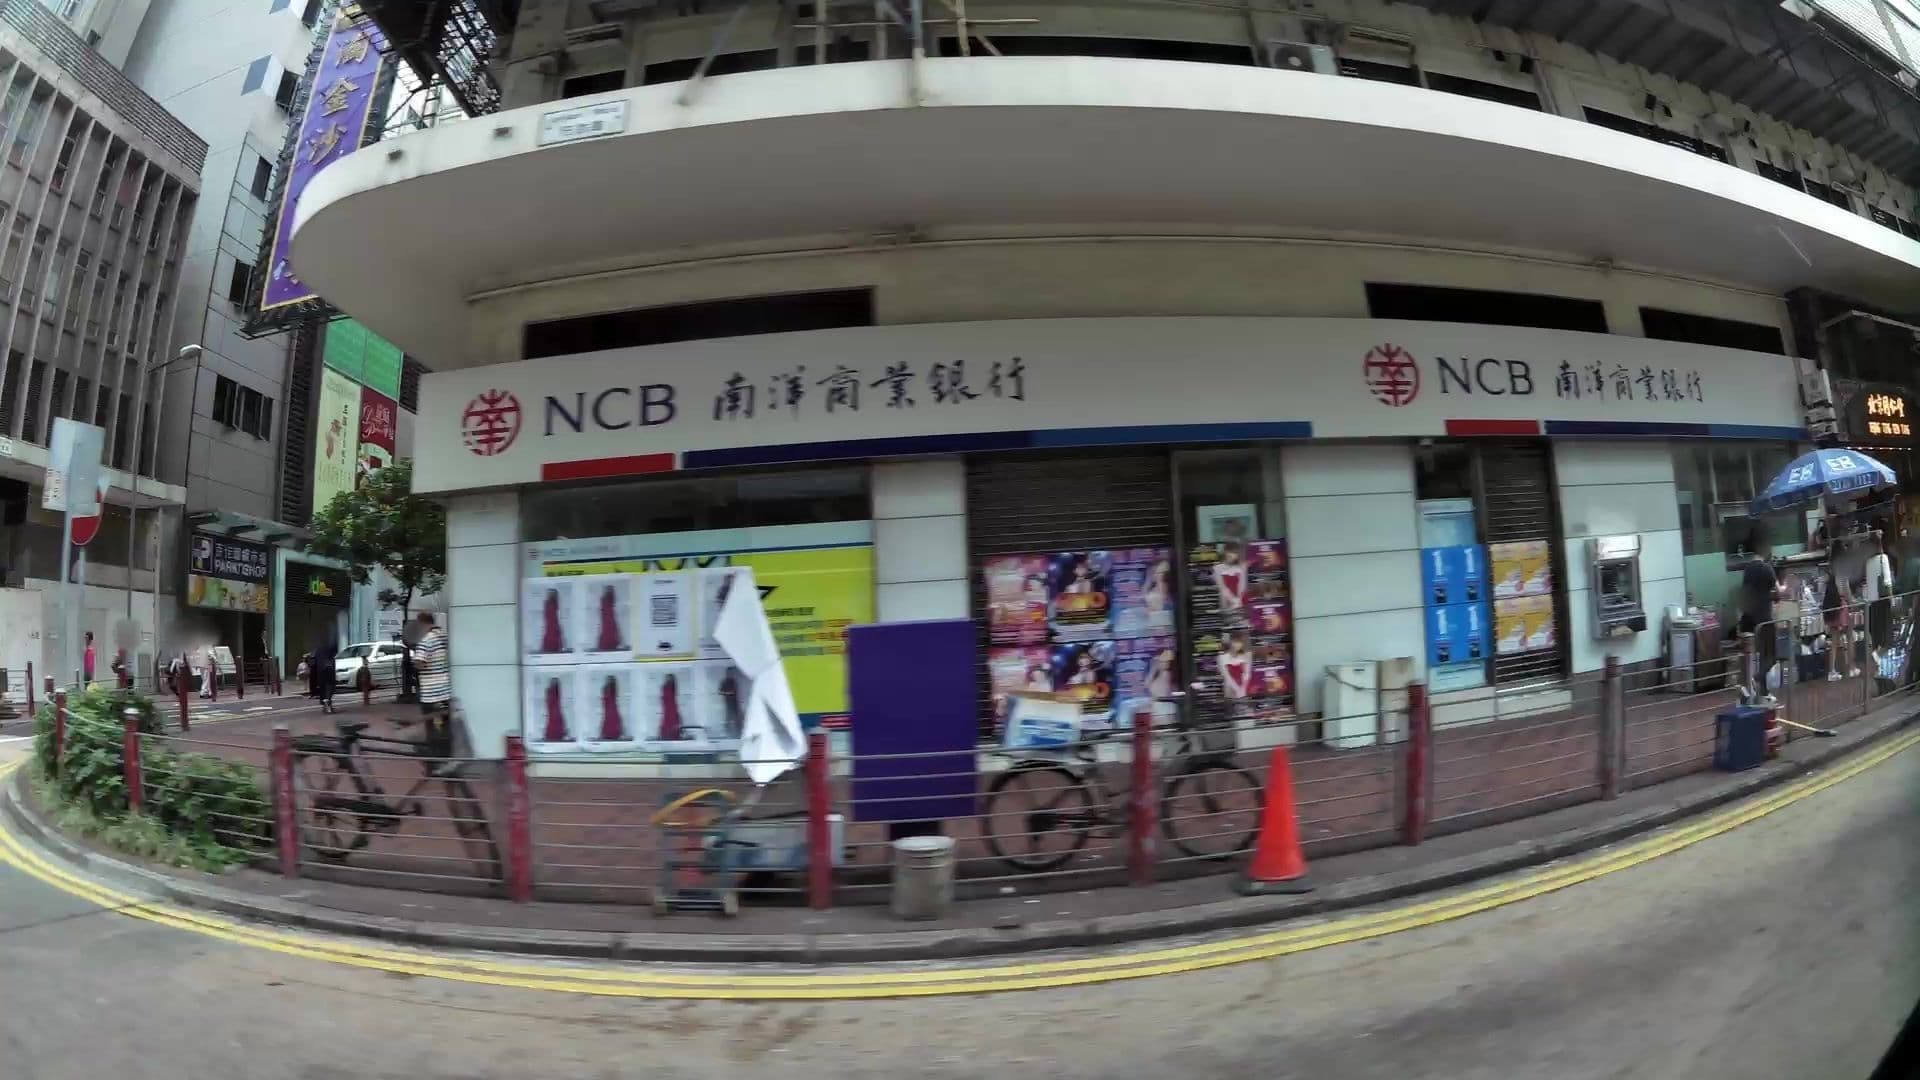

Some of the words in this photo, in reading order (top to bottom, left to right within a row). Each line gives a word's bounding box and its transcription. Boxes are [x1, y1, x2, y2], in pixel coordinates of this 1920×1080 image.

[543, 383, 677, 436] NCB
[712, 356, 1027, 422] 南洋商業銀行
[1436, 355, 1535, 396] NCB
[1555, 359, 1704, 403] 南洋商業銀行
